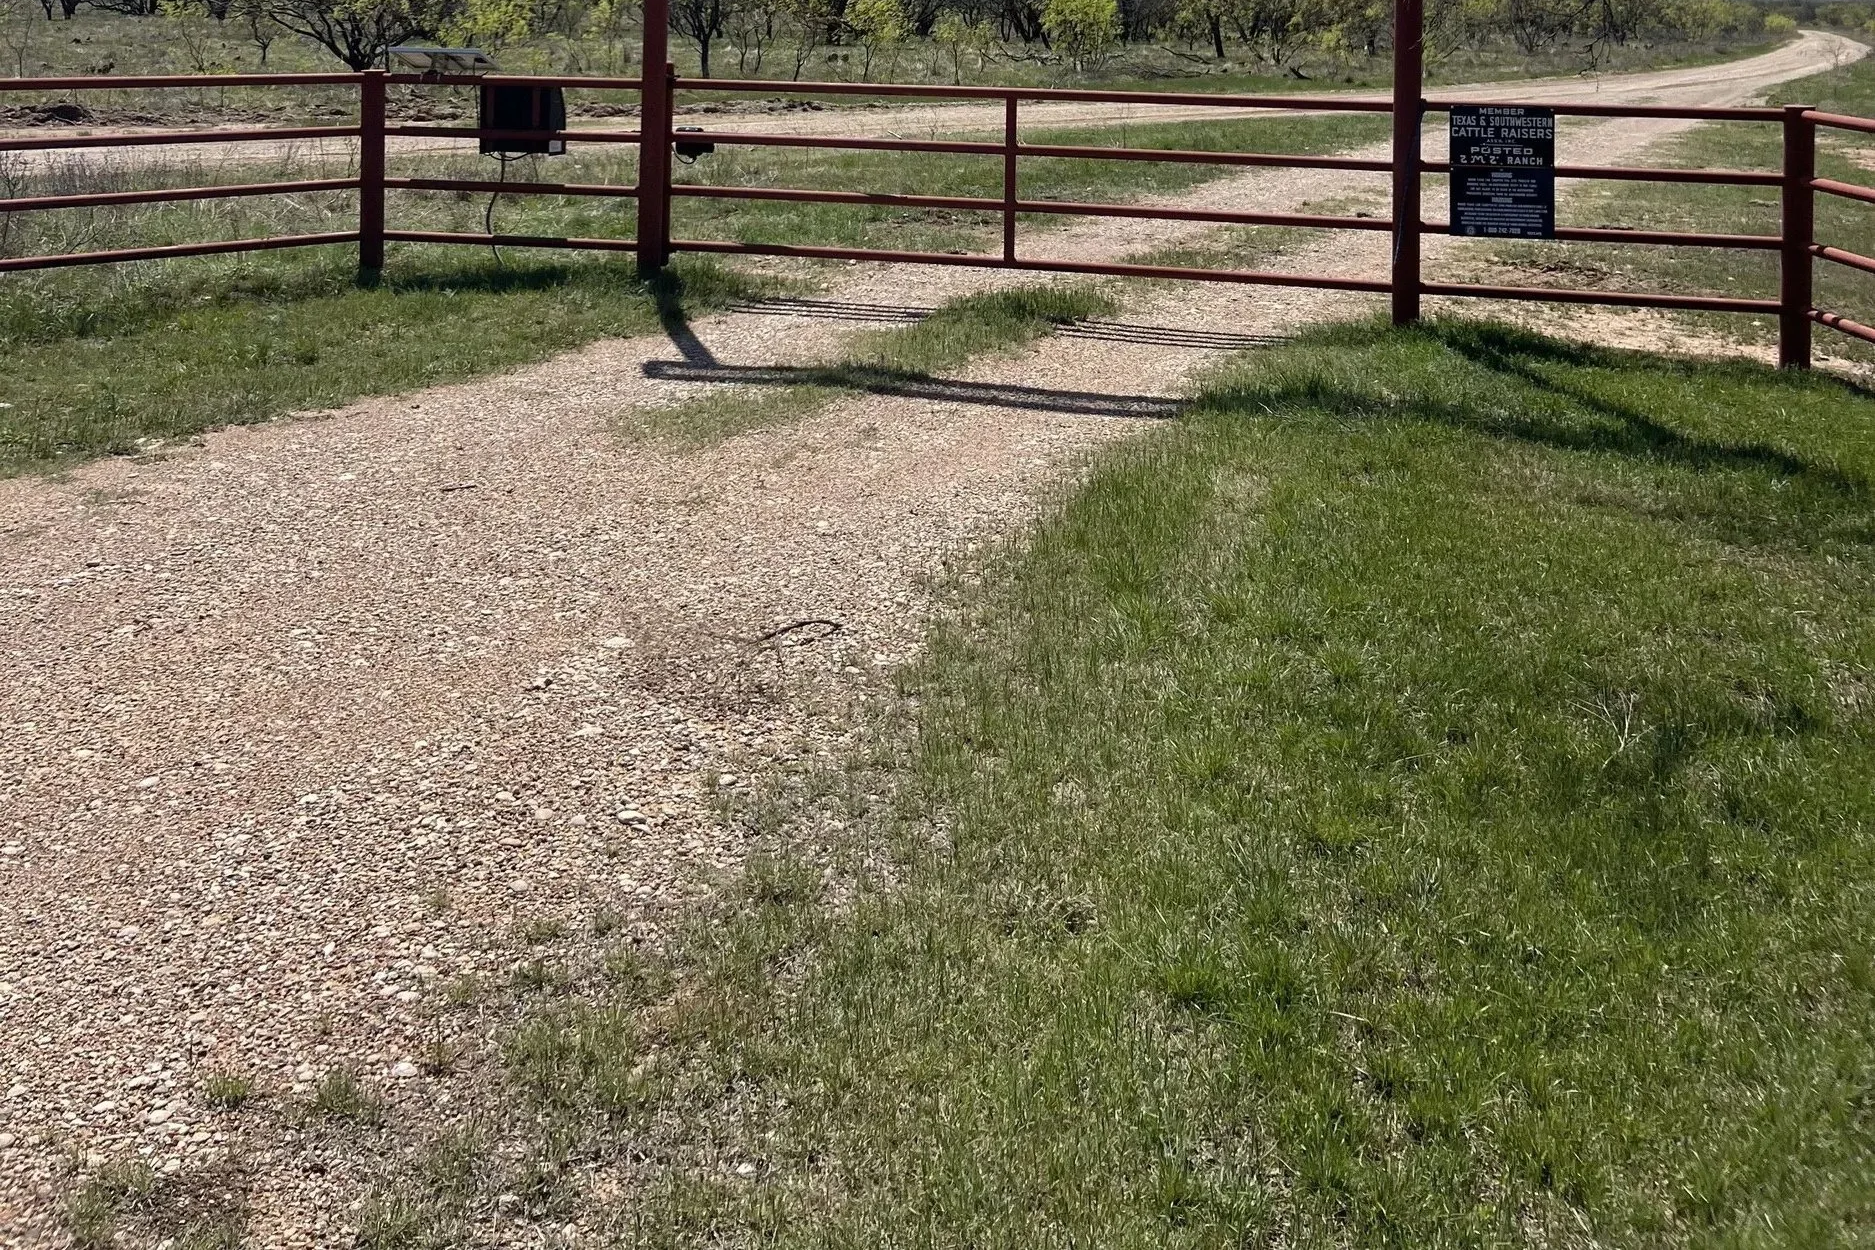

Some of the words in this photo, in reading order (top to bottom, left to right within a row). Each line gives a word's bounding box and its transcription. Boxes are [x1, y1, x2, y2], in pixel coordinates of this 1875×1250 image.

[1479, 107, 1525, 115] MEMBER
[1452, 115, 1476, 126] TEXAS
[1480, 116, 1486, 126] &
[1490, 116, 1553, 127] SOUTHWESTERN
[1451, 127, 1495, 137] CATTLE
[1501, 128, 1553, 139] RAISERS
[1470, 146, 1533, 155] POSTED
[1507, 156, 1543, 165] RANCH
